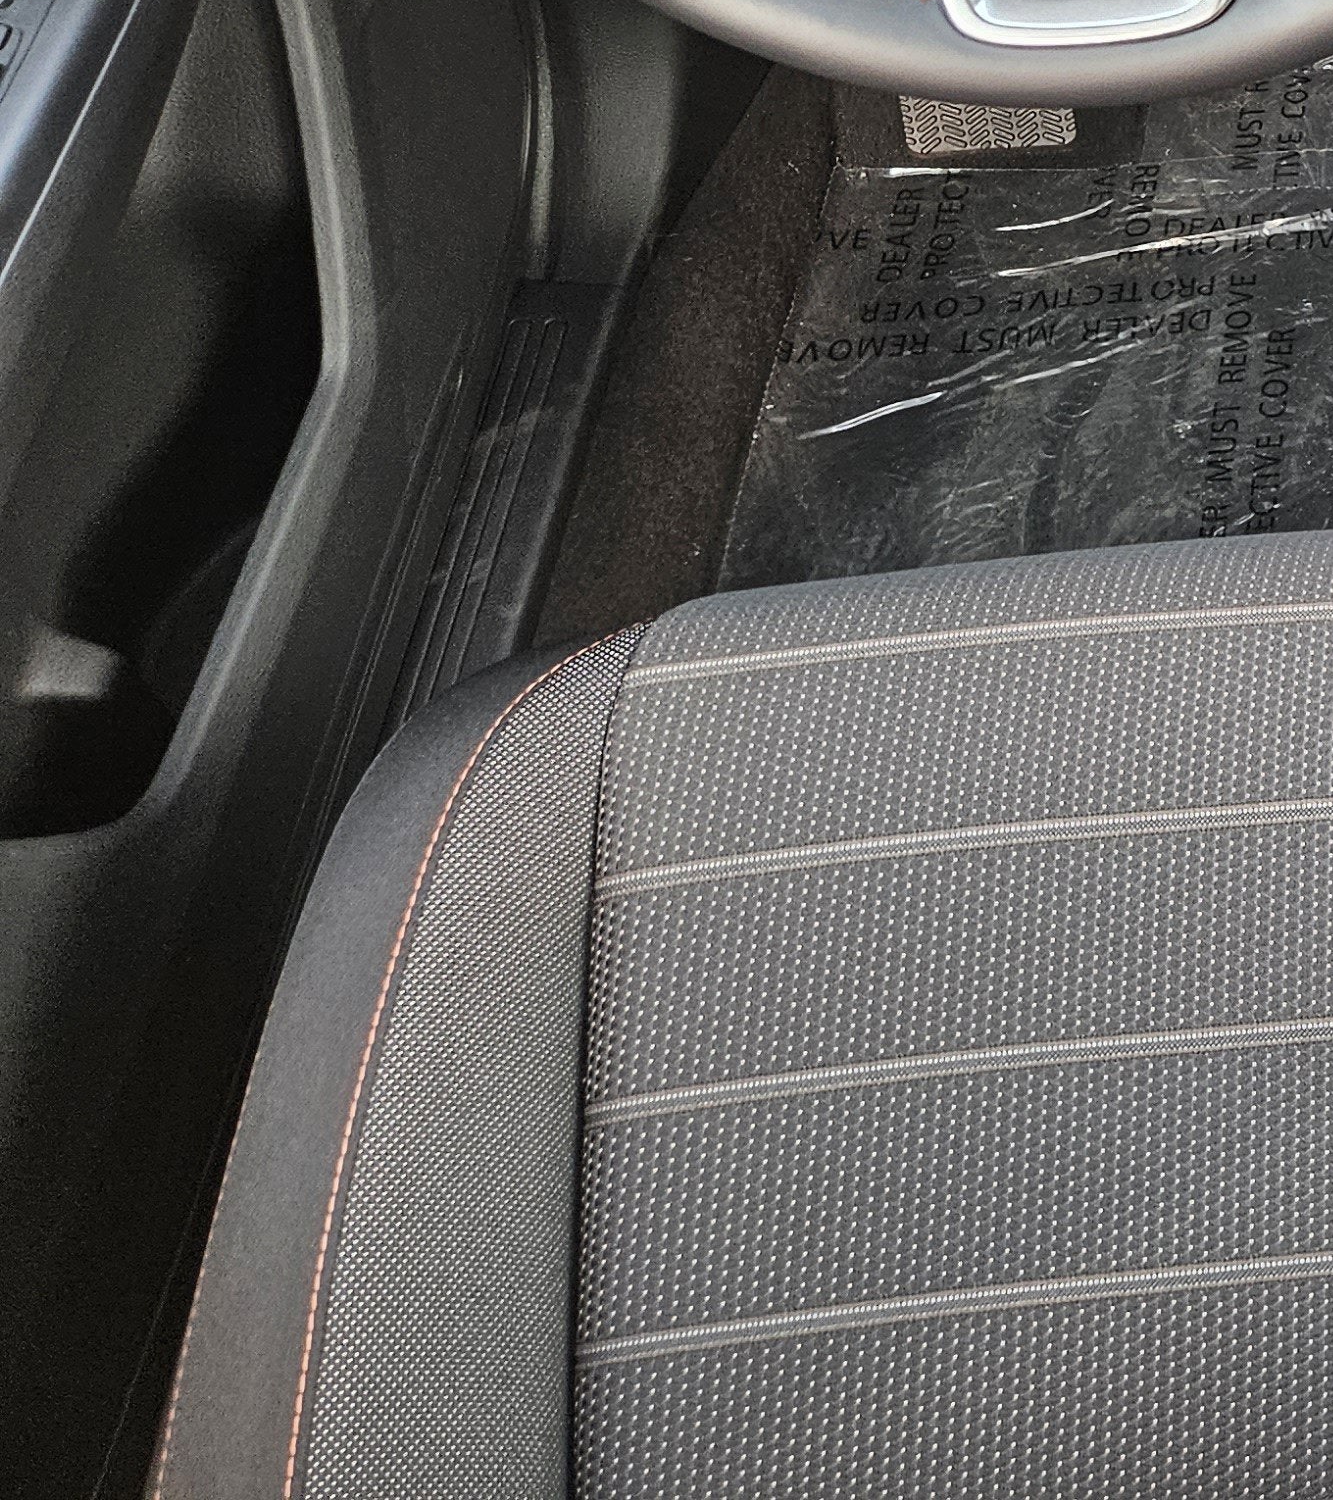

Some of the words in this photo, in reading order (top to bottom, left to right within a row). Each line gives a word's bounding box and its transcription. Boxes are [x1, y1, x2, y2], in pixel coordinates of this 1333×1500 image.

[858, 295, 986, 324] COVER
[1003, 274, 1216, 313] PROTECTIVE
[1217, 272, 1258, 385] REMOVE
[1258, 327, 1298, 418] COVER
[1204, 401, 1241, 483] MUST
